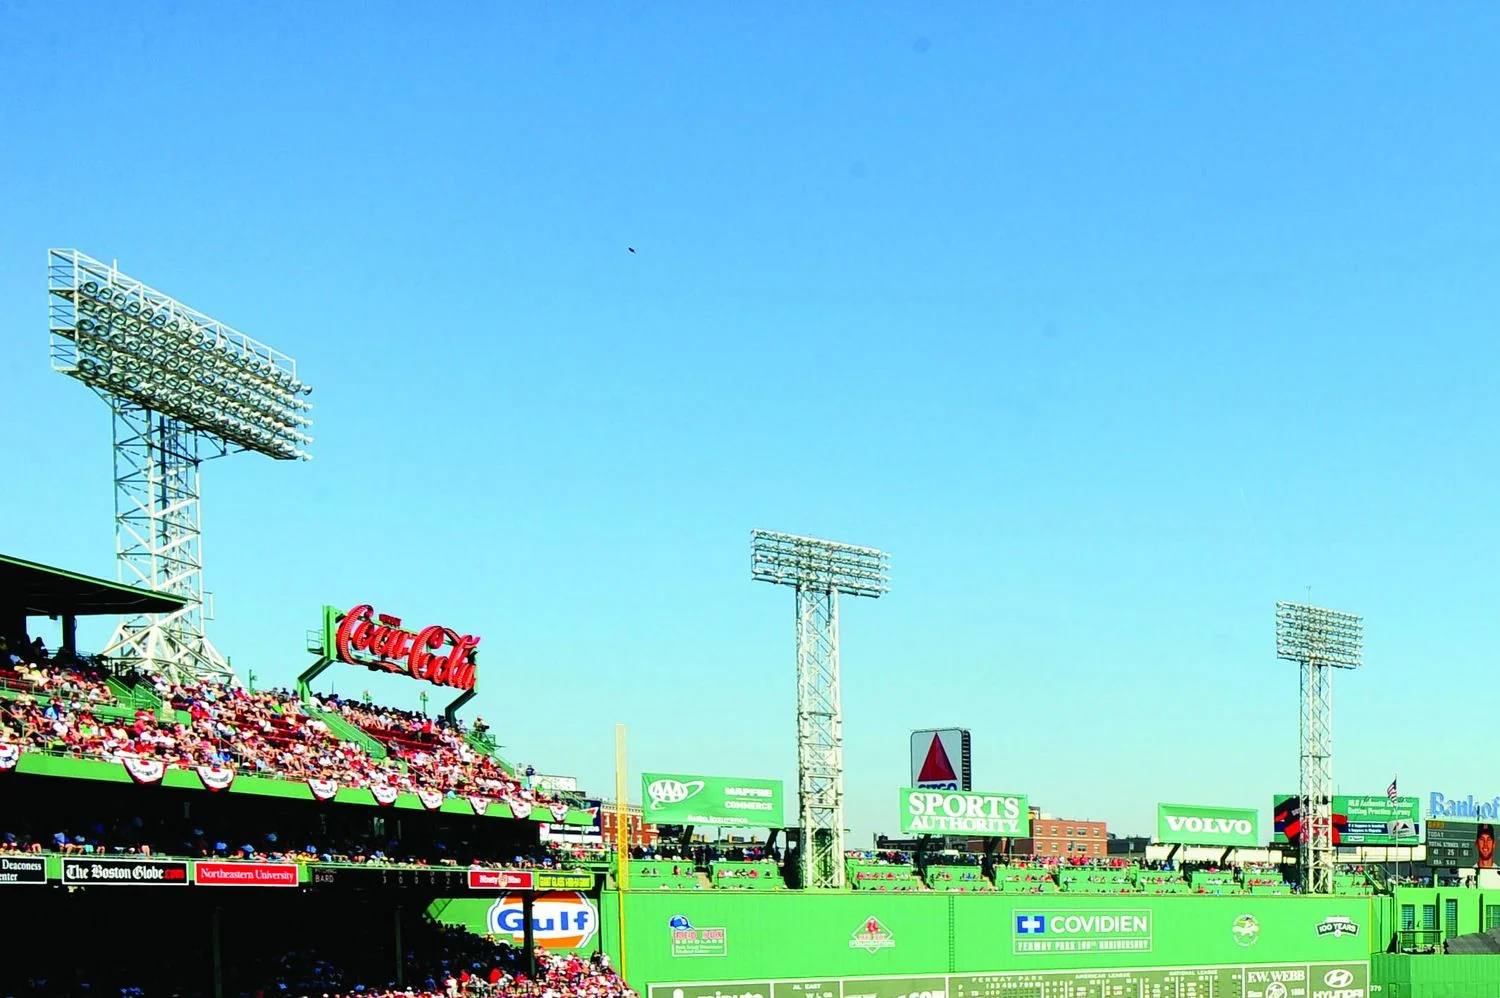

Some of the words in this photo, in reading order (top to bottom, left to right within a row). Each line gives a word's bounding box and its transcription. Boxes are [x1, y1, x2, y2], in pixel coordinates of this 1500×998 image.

[336, 604, 481, 690] Coca-Cola
[652, 781, 684, 801] AAA
[725, 801, 773, 810] COMMERCE
[908, 792, 1020, 819] SPORTS
[1430, 792, 1478, 818] Bank
[1481, 797, 1500, 819] of
[1164, 815, 1252, 835] VOLVO
[2, 859, 42, 871] Deaconess
[66, 864, 89, 880] The
[91, 864, 132, 880] Boston
[201, 868, 254, 879] Northeastern
[255, 870, 294, 883] University
[497, 909, 589, 932] Gulf
[1050, 915, 1147, 933] COVIDIEN
[1319, 924, 1332, 933] 100
[1333, 923, 1356, 932] YEARS
[1018, 941, 1052, 951] FENWAY
[1055, 941, 1075, 951] PARK
[1271, 970, 1305, 982] WEBB
